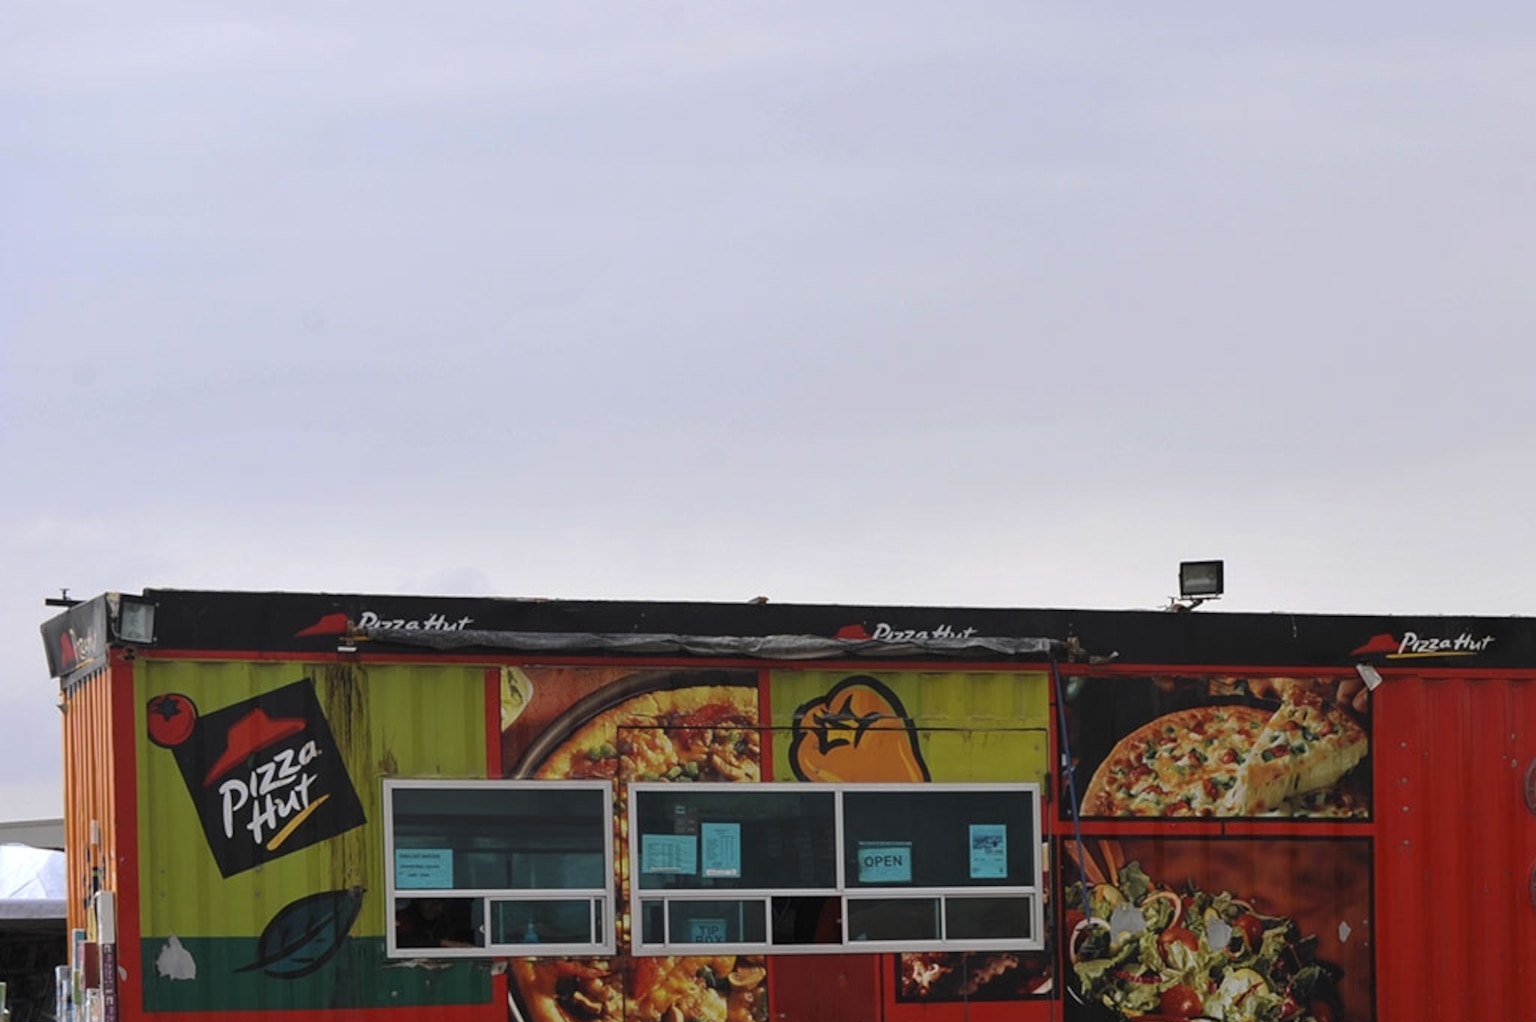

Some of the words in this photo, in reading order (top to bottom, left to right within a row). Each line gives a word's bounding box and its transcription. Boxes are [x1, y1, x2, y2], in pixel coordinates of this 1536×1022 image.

[359, 611, 419, 630] Pizza
[422, 613, 474, 631] Hut
[1398, 631, 1452, 654] Pizza
[1453, 632, 1496, 651] Hut
[219, 740, 318, 838] Pizza
[246, 773, 318, 844] Hut
[864, 854, 903, 867] OPEN
